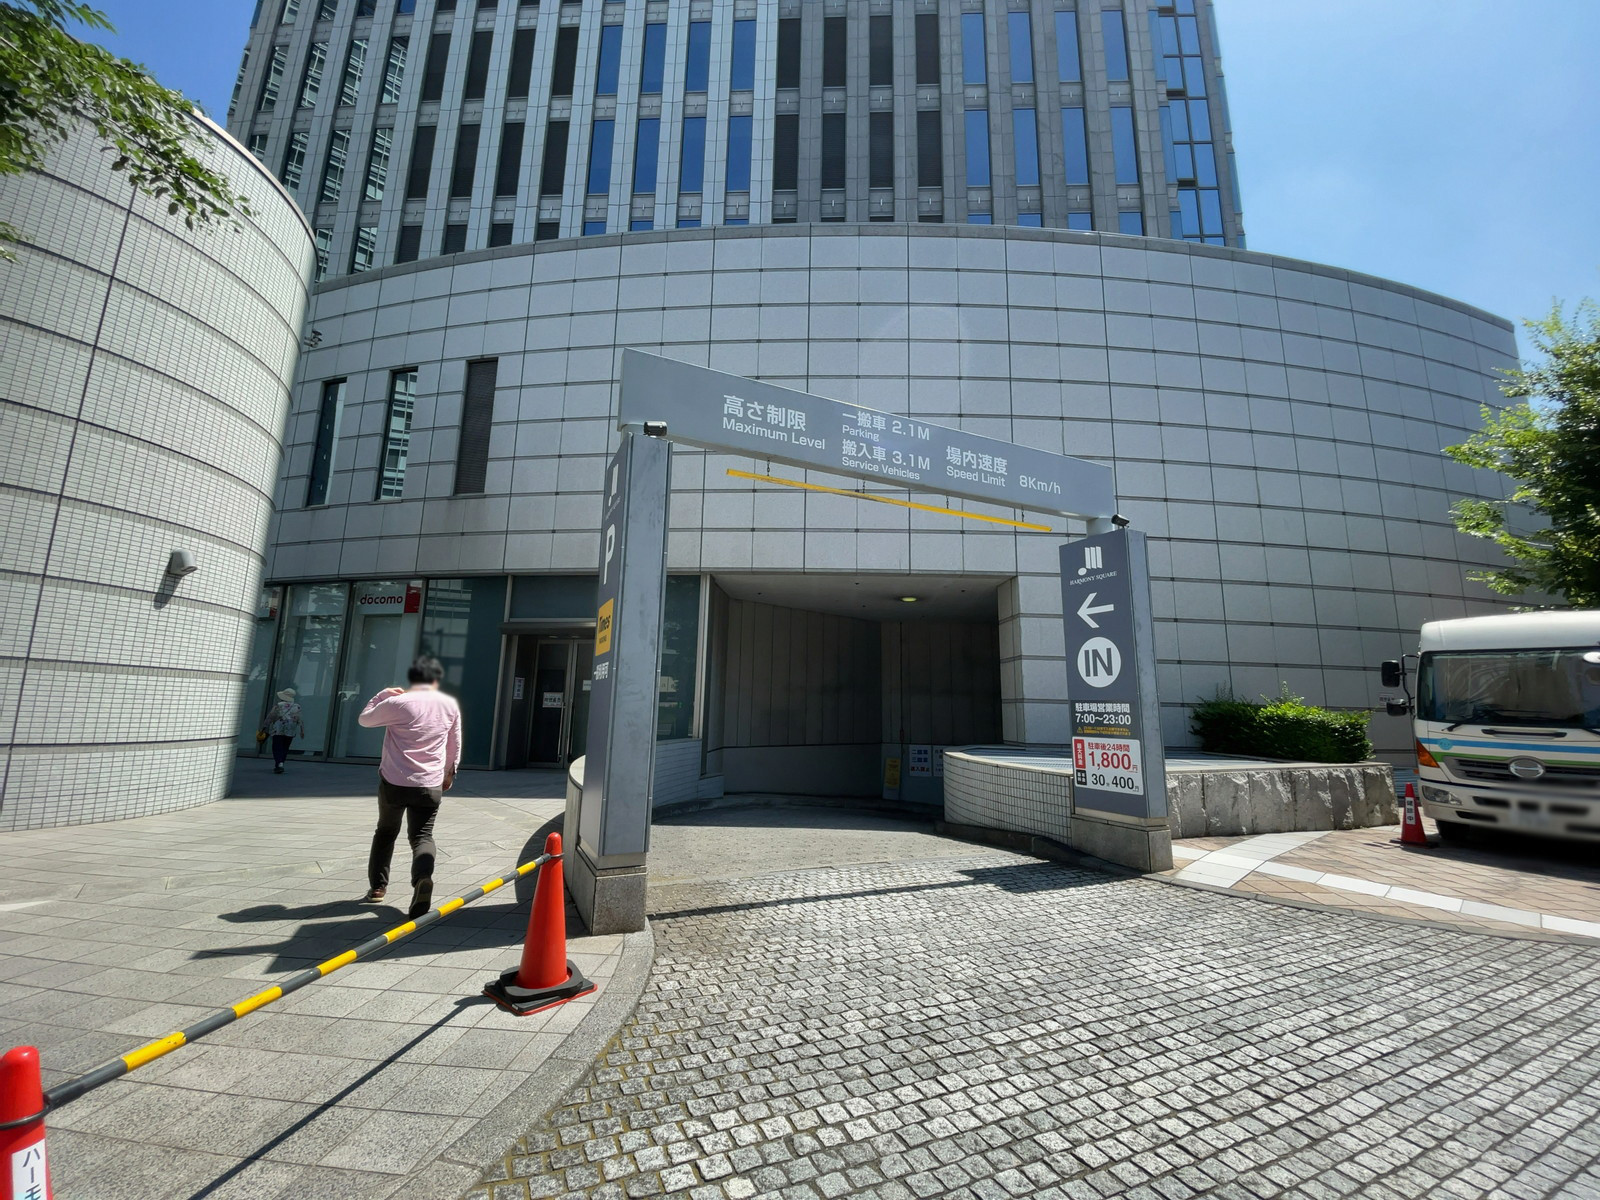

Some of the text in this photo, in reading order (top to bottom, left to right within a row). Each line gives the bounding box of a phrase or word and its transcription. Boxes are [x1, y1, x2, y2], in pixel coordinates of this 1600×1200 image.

[723, 394, 806, 431] 高さ制限
[722, 416, 826, 450] Maximum Level
[842, 424, 880, 442] Parking
[891, 420, 930, 441] 2.1M
[842, 438, 930, 471] 搬入車 3.1M
[946, 445, 1008, 476] 場内速度
[842, 456, 920, 480] Service Vehicles
[946, 465, 1006, 487] Speed Limit
[1019, 474, 1061, 495] 8Km/h
[603, 523, 616, 585] P
[1095, 570, 1118, 580] SQUARE
[360, 593, 404, 605] docomo
[1084, 647, 1114, 678] IN
